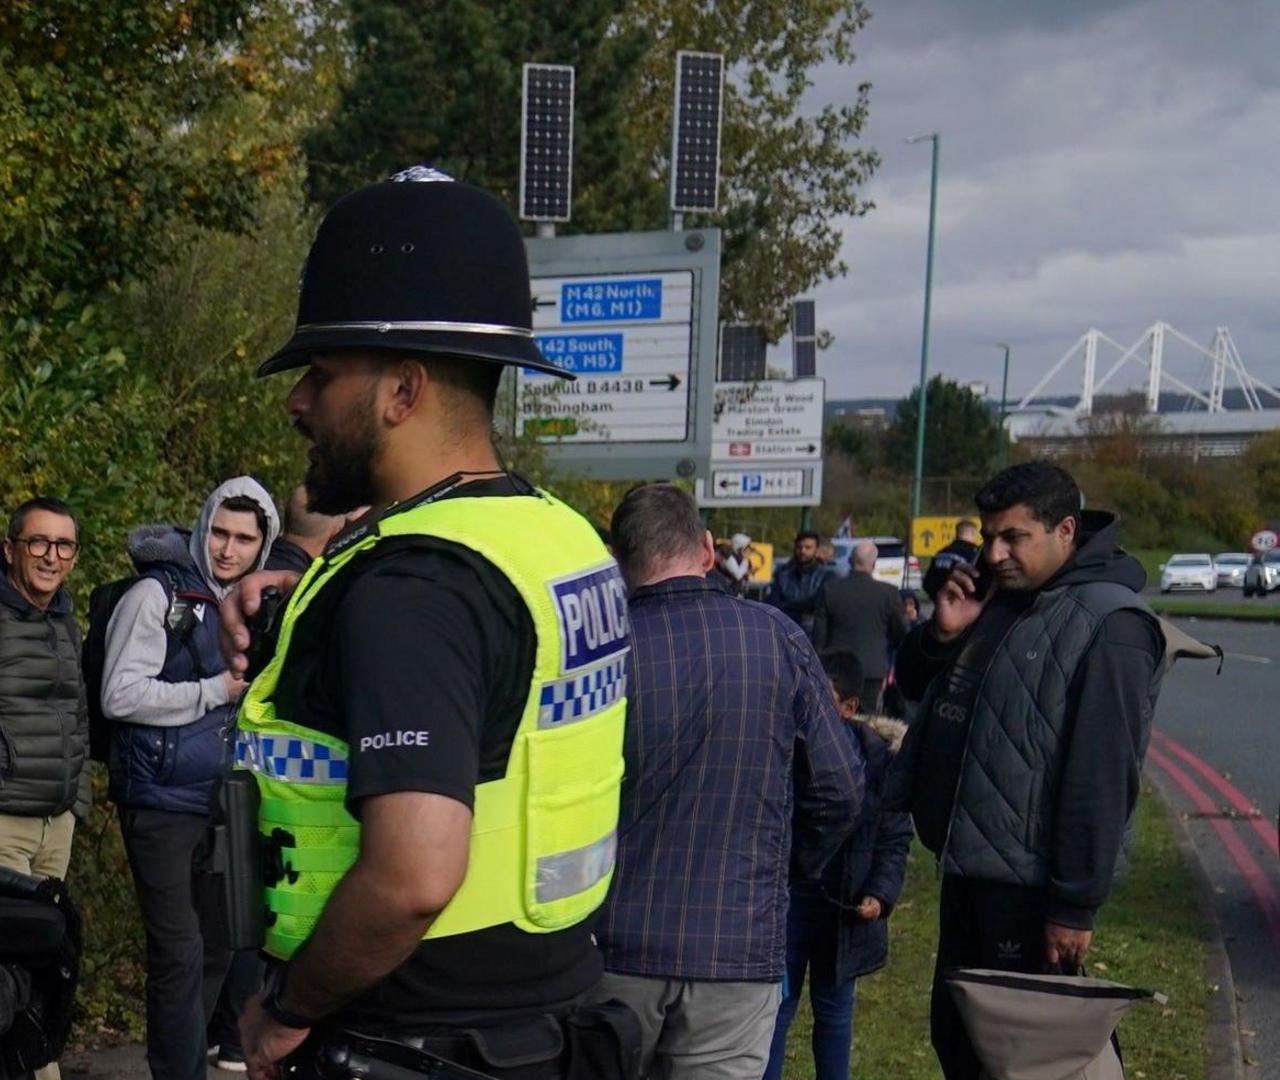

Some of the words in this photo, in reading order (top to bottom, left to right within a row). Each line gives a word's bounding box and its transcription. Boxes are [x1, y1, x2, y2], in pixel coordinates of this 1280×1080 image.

[523, 402, 613, 415] Birmingham
[560, 577, 631, 657] POLIC
[360, 731, 429, 752] POLICE
